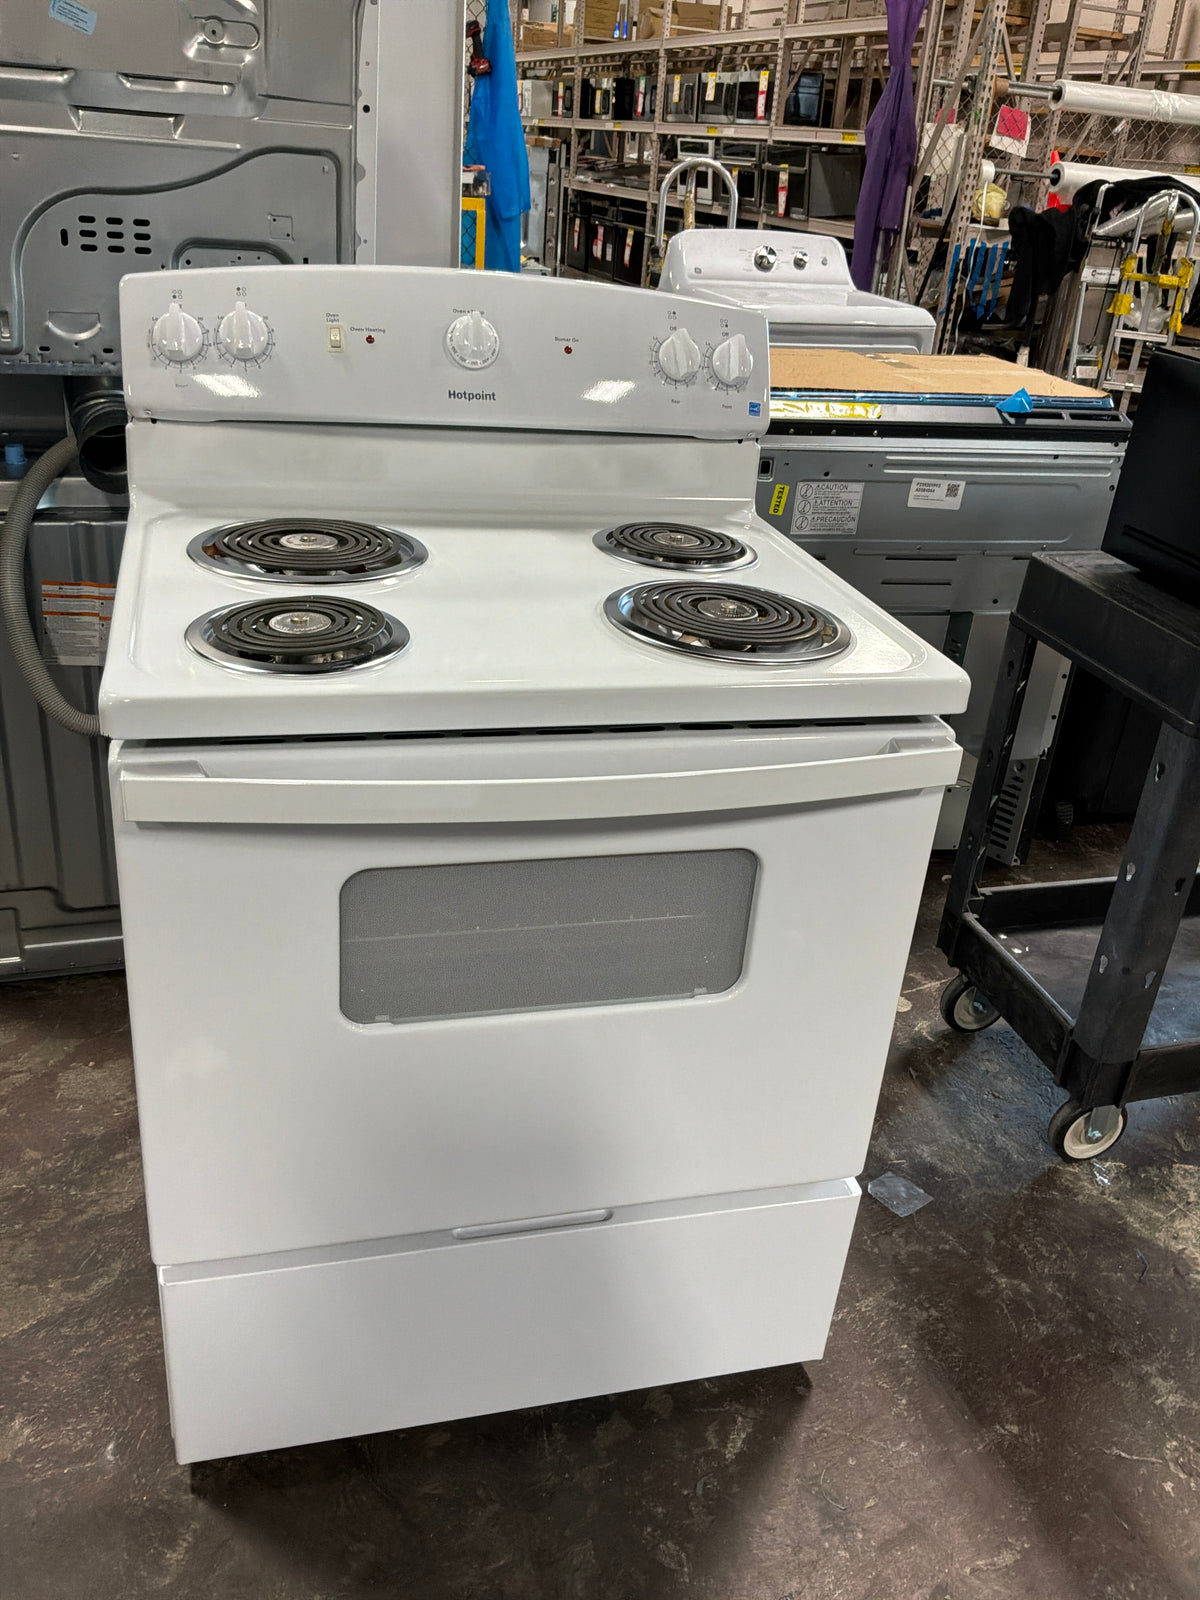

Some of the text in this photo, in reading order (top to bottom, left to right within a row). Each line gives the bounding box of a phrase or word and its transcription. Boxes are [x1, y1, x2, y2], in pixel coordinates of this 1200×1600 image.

[448, 390, 496, 402] Hotpoint
[821, 483, 849, 491] CAUTION
[772, 485, 786, 514] TESTED
[819, 499, 853, 507] ATTENTION
[815, 515, 857, 523] PRECAUCIÓN
